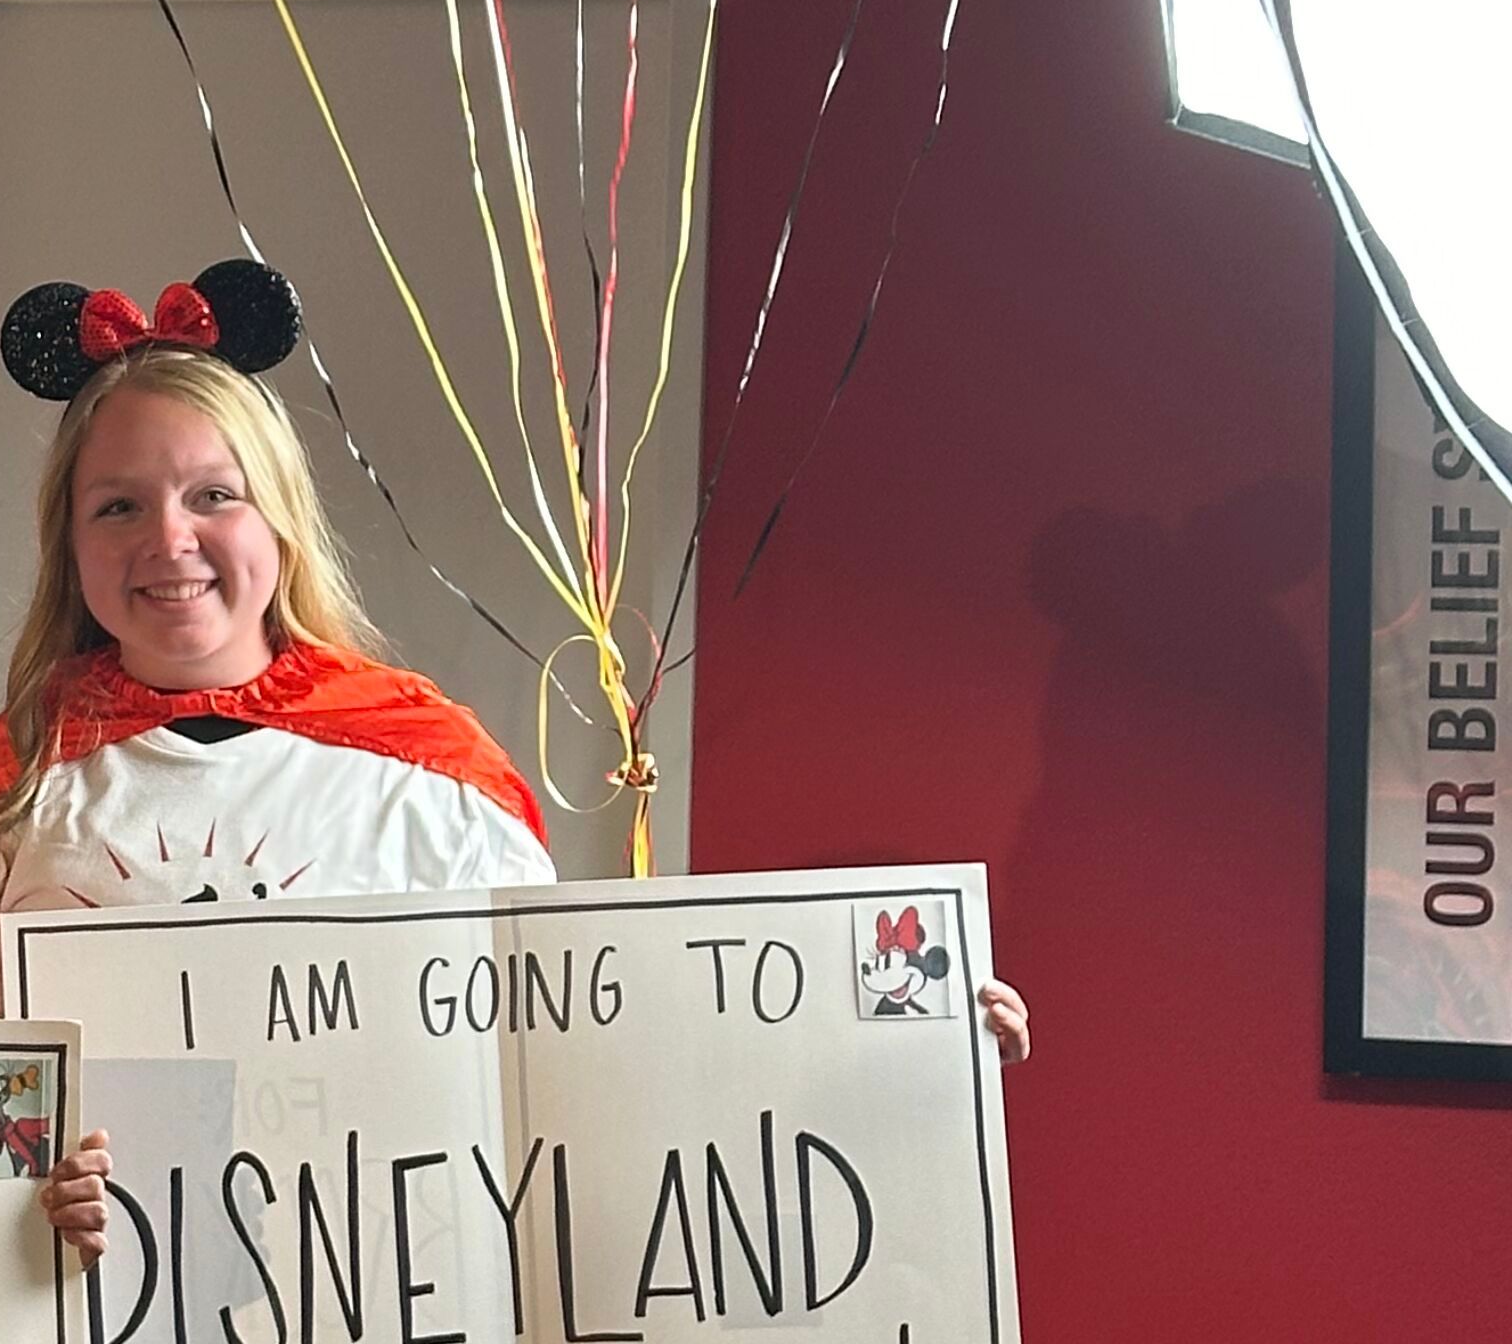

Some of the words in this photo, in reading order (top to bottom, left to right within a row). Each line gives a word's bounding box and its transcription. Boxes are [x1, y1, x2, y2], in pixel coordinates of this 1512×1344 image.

[1428, 505, 1500, 752] BELIEF
[1423, 780, 1495, 928] OUR
[180, 970, 195, 1051] I
[266, 959, 360, 1043] AM
[419, 945, 623, 1037] GOING
[685, 938, 804, 1024] TO
